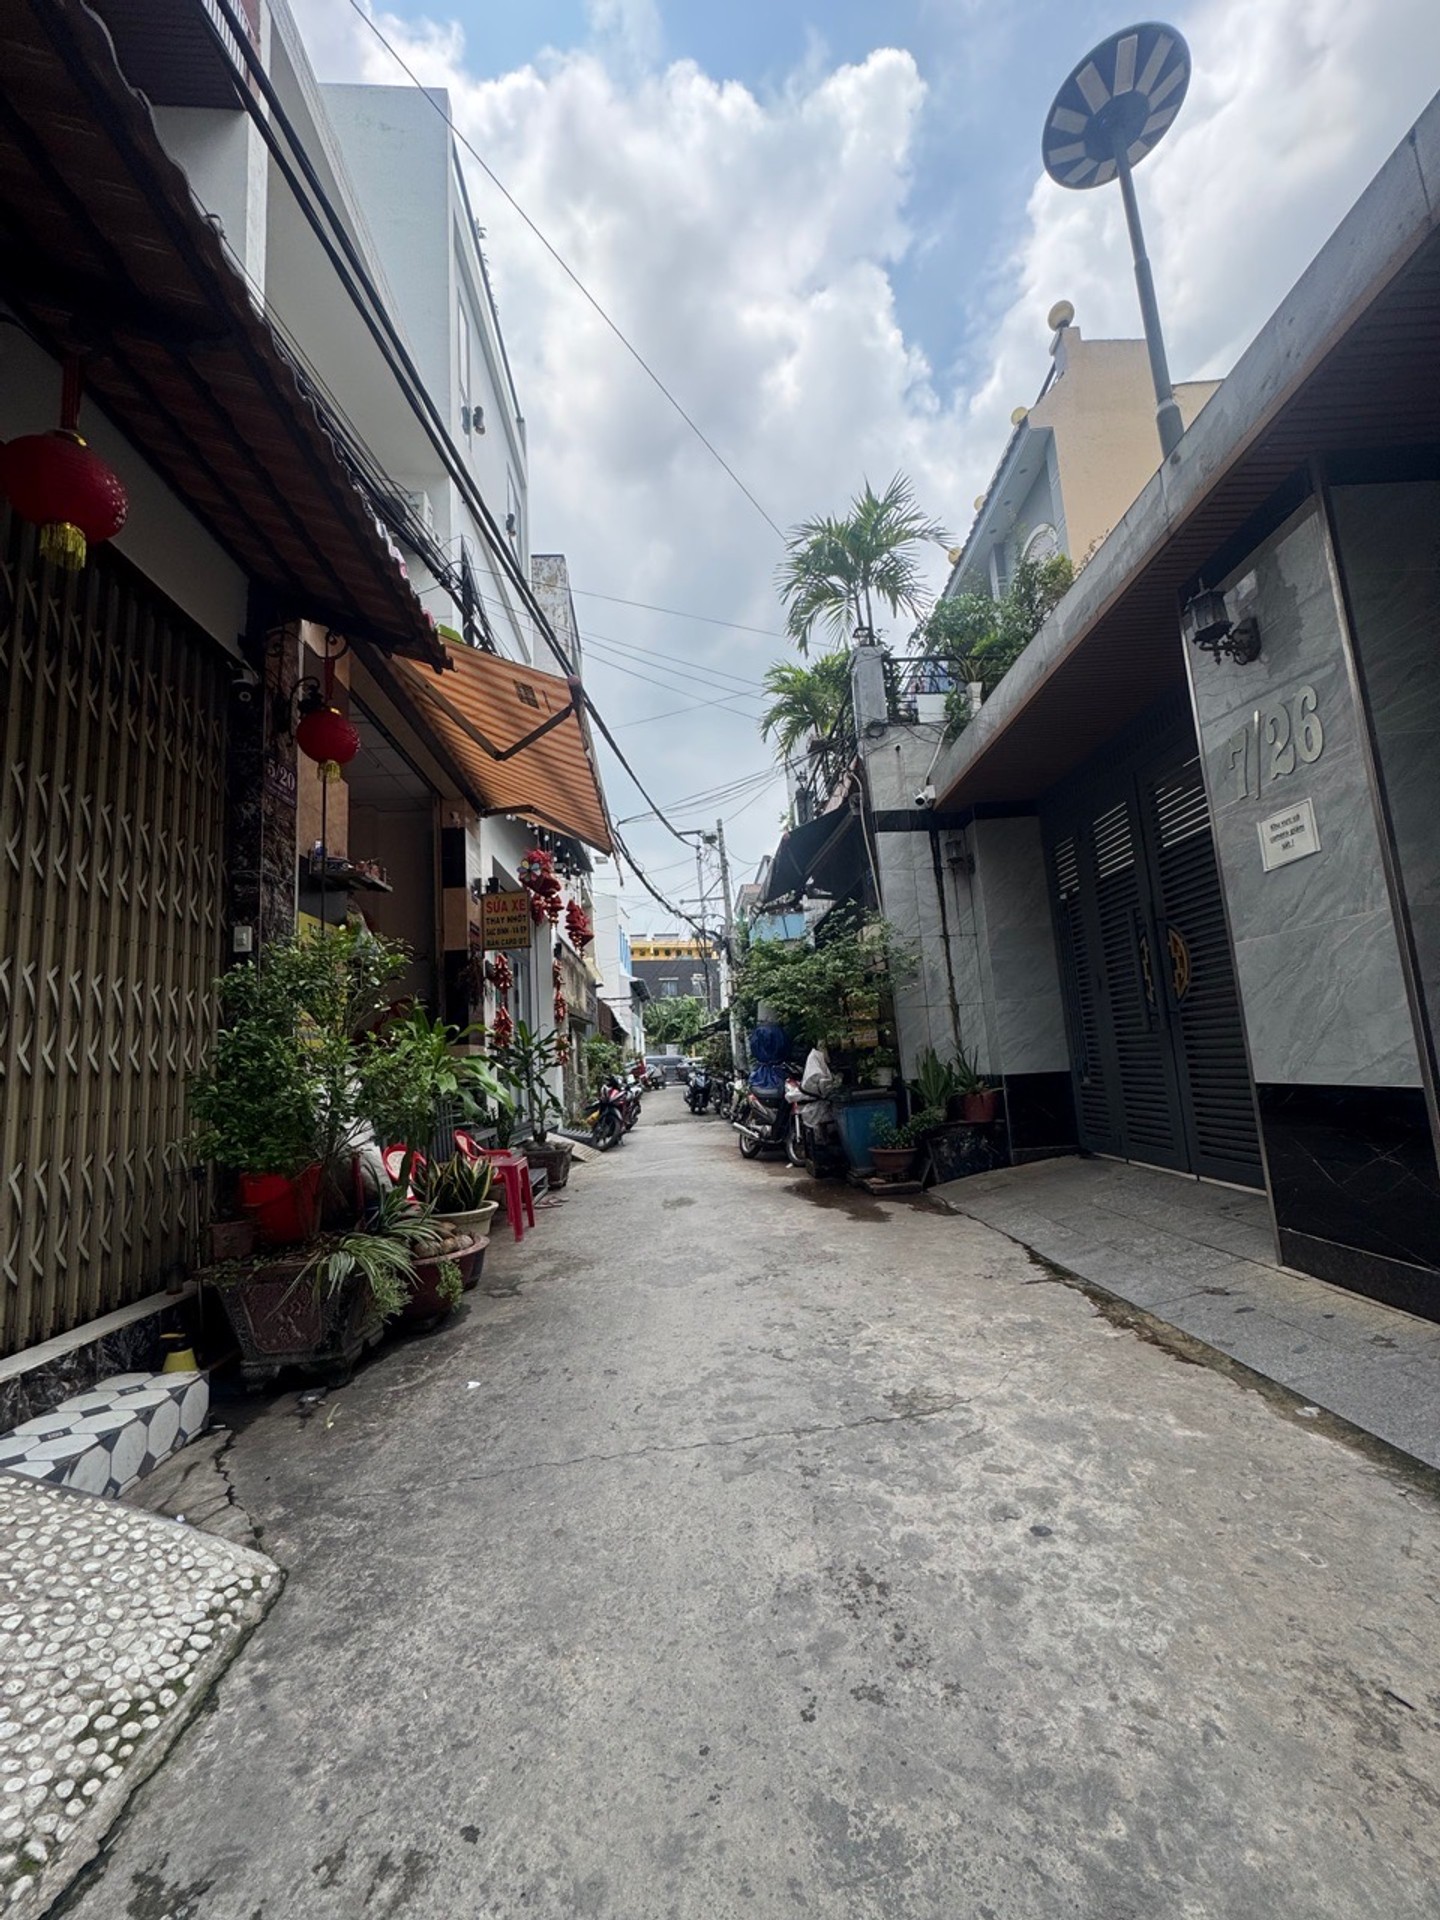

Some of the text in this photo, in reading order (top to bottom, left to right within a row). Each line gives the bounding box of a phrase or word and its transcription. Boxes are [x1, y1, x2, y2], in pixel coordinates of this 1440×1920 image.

[1228, 685, 1324, 800] 7/26
[267, 758, 296, 791] 5/20
[512, 899, 526, 912] XE
[486, 916, 504, 925] THAY
